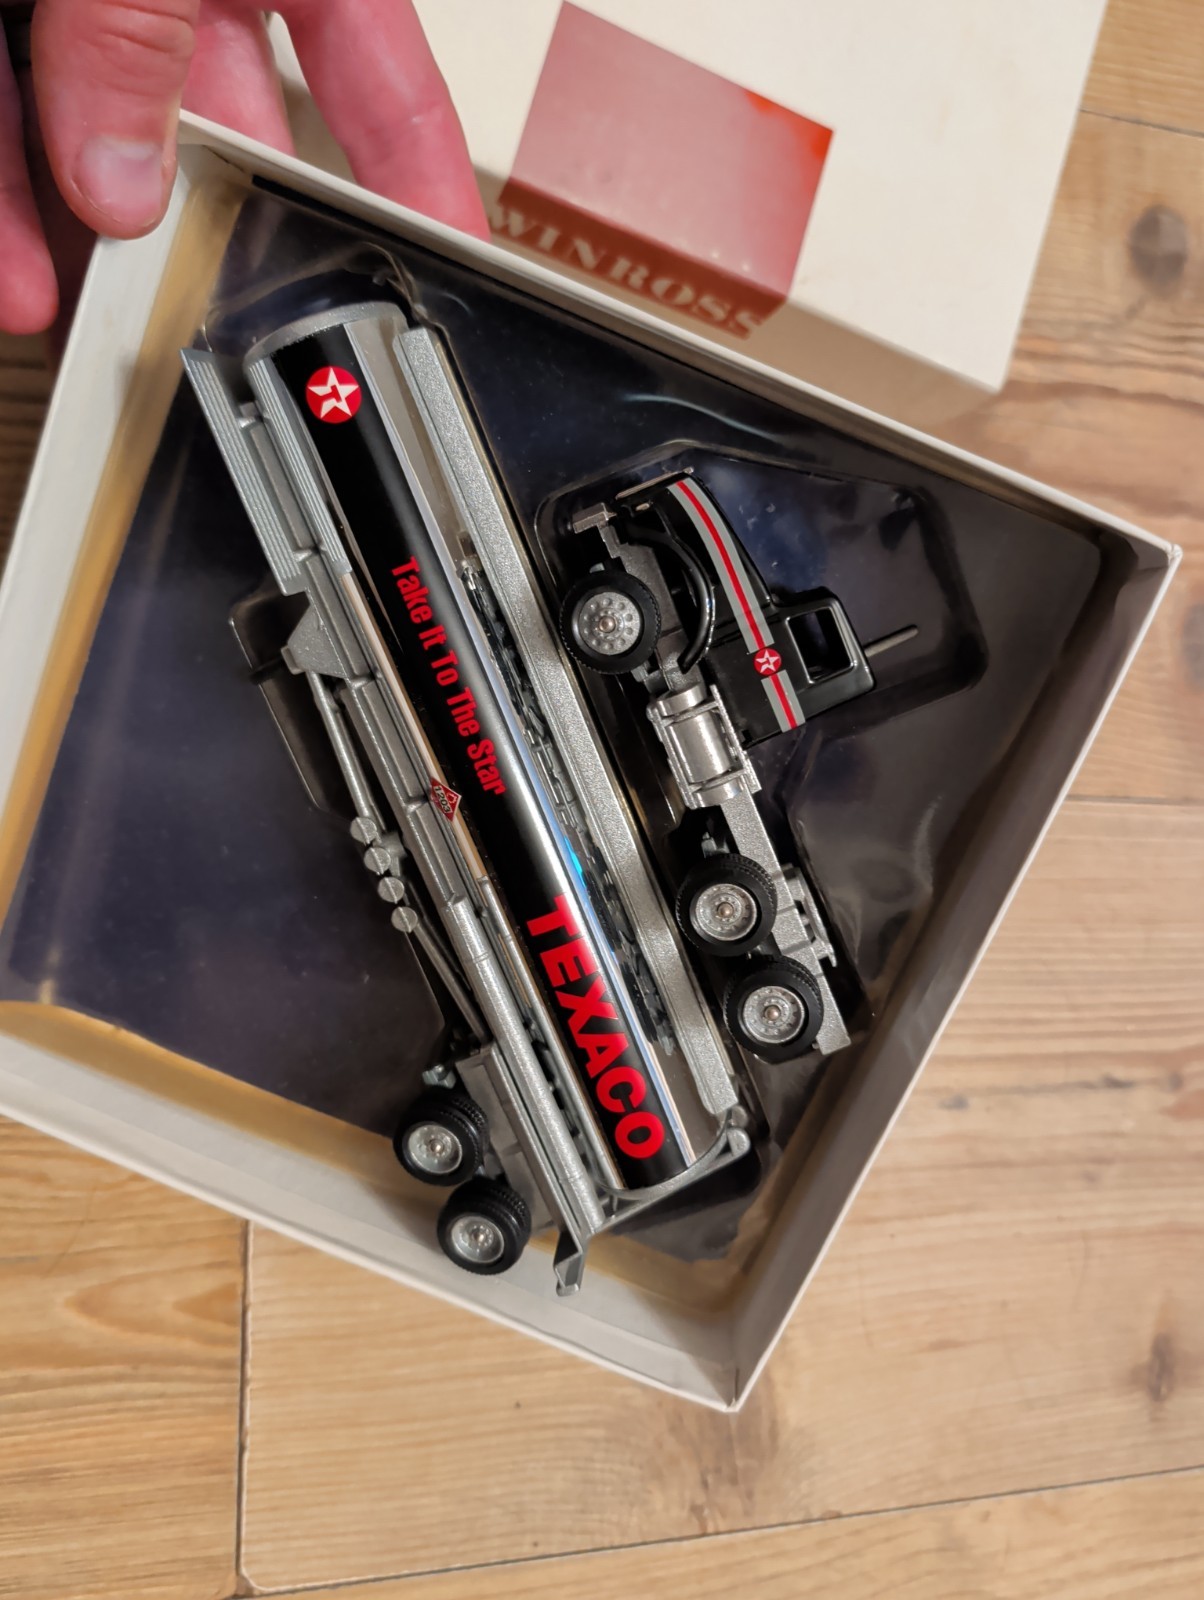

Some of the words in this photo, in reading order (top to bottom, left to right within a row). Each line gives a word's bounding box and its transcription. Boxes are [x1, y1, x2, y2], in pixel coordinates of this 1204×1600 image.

[489, 203, 757, 330] WINROSS
[391, 556, 433, 624] Take
[419, 624, 447, 650] It
[431, 649, 459, 687] To
[447, 687, 480, 737] The
[467, 738, 506, 796] Star
[434, 785, 452, 813] 1203
[526, 893, 665, 1159] TEXACO
